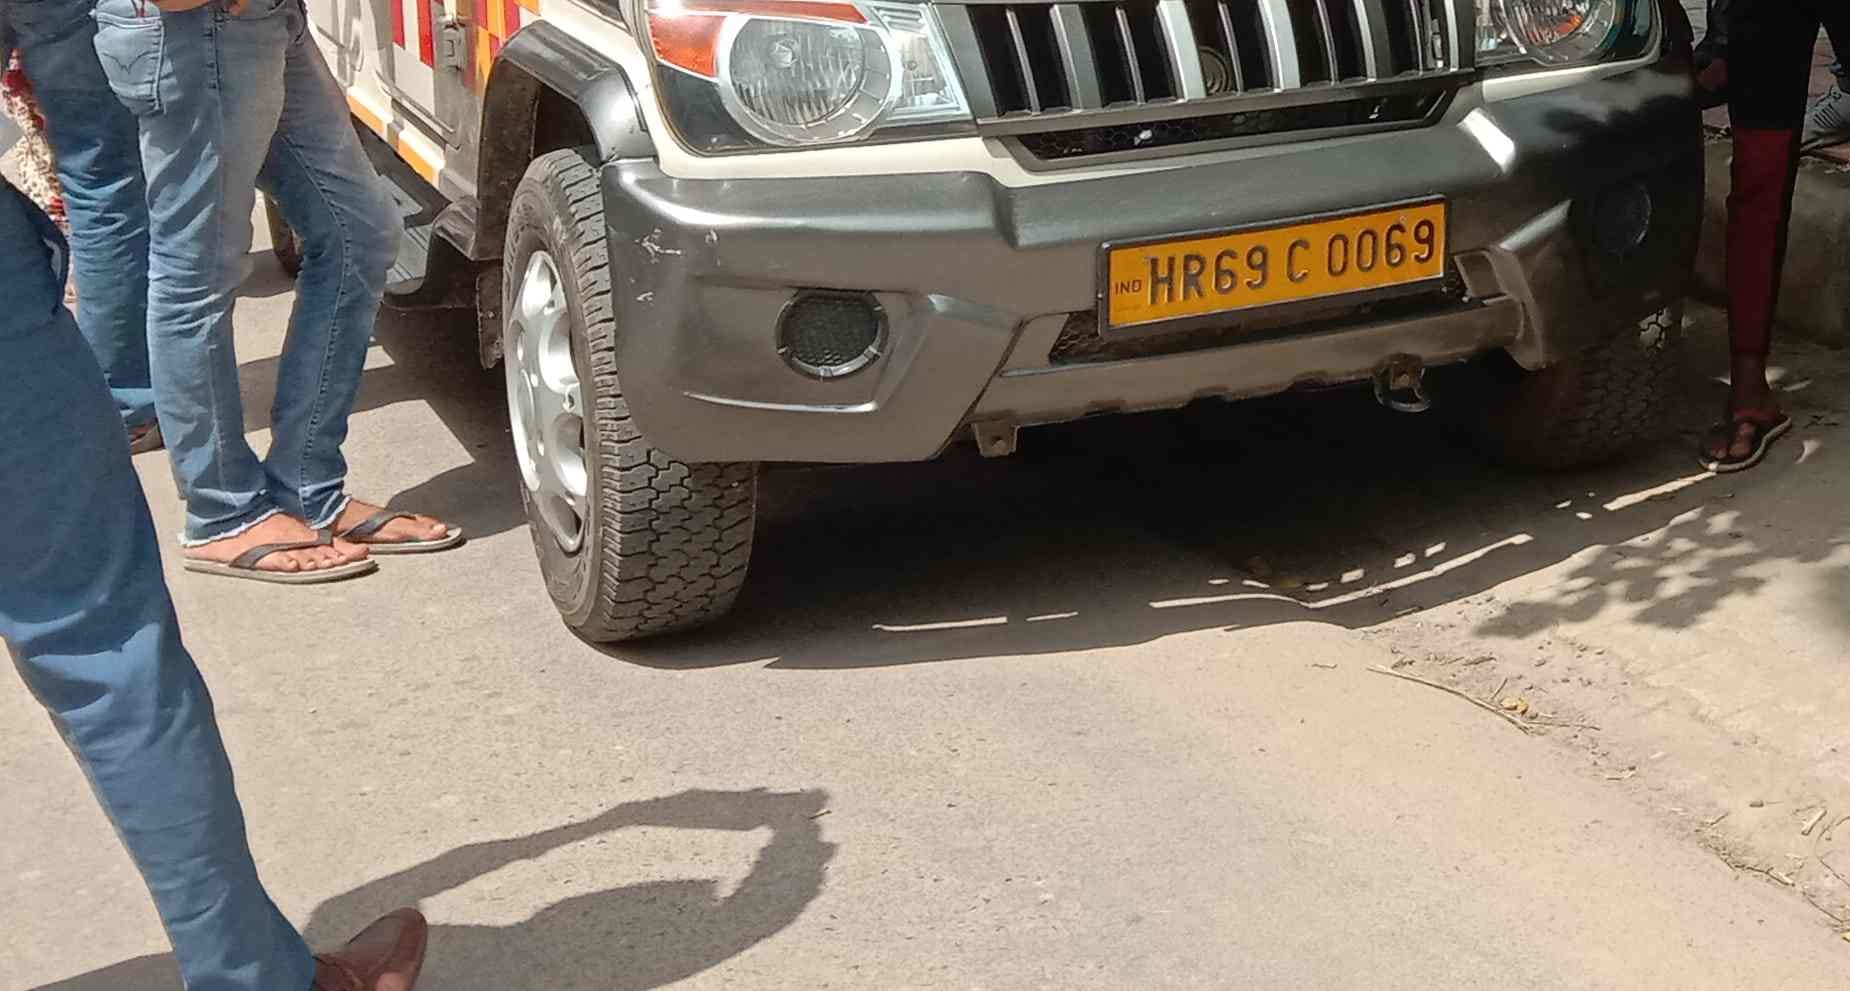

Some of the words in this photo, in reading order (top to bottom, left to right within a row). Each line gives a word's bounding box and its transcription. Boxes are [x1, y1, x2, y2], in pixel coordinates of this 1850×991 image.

[1114, 278, 1143, 295] IND
[1148, 245, 1269, 305] HR69
[1286, 239, 1311, 284] C
[1327, 219, 1436, 277] 0069
